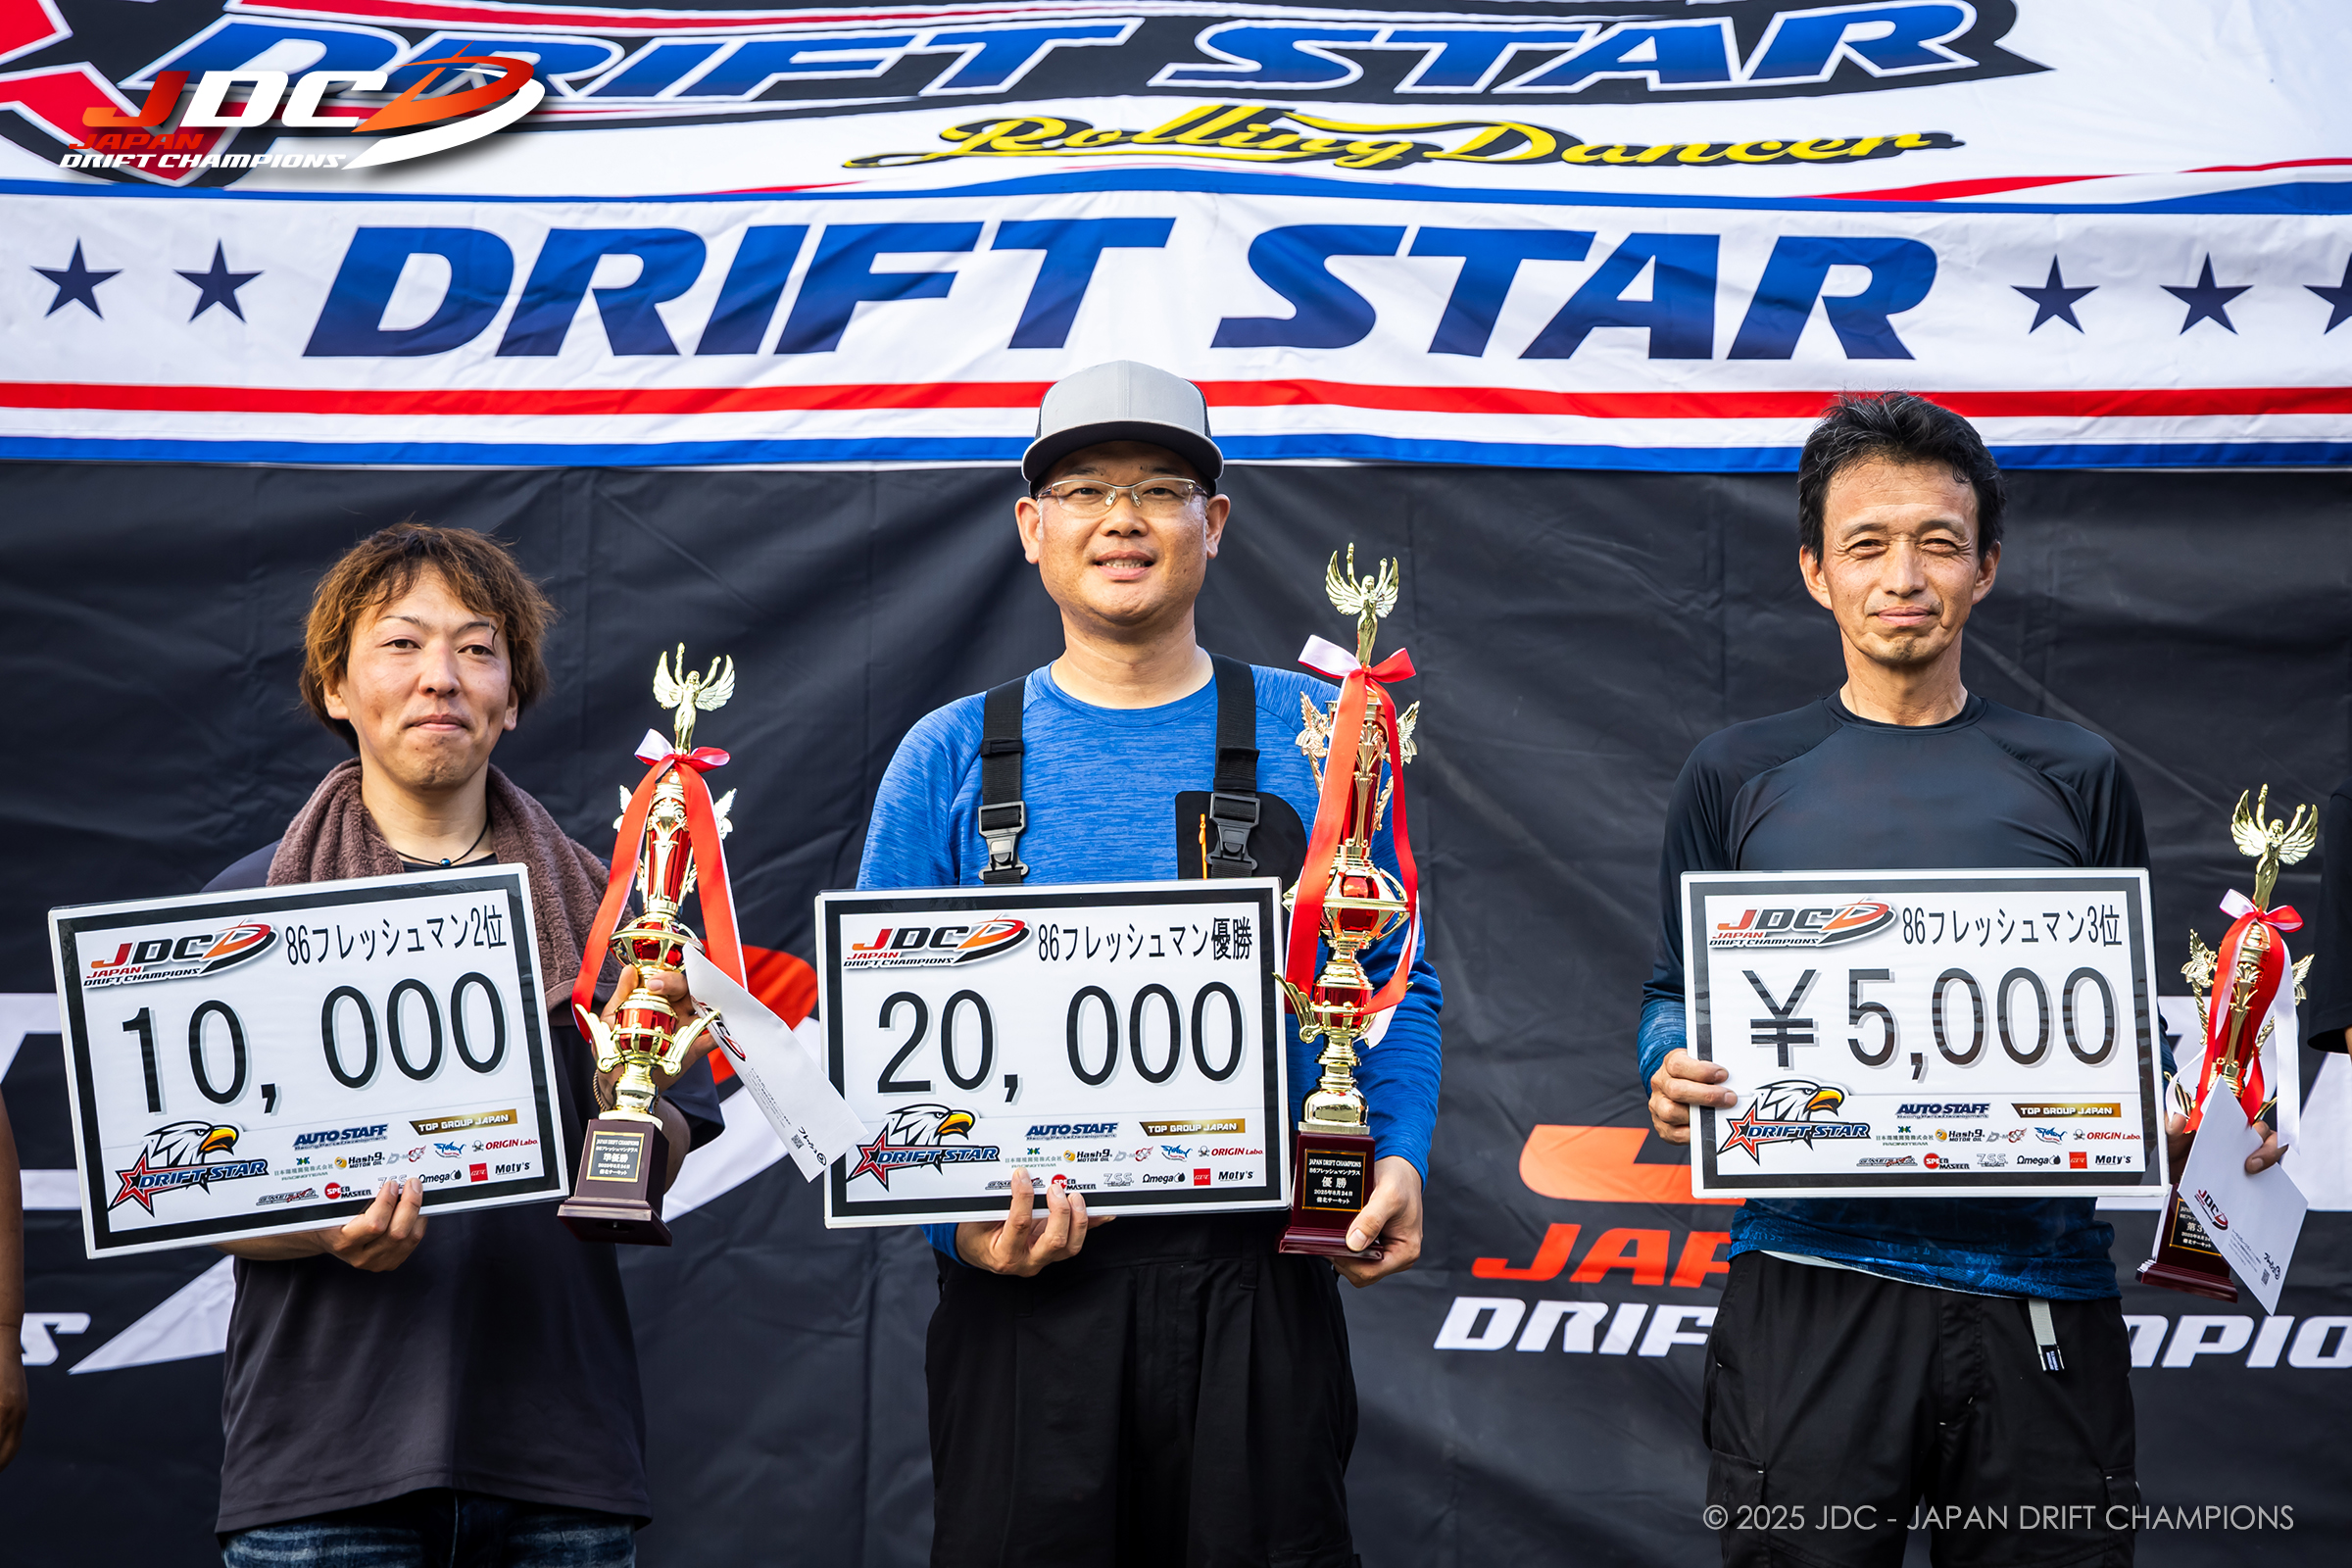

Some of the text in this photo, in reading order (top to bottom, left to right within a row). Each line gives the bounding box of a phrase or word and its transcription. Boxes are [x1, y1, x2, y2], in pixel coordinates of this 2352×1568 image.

[1147, 1, 1976, 94] STAR
[842, 105, 1965, 170] Rolling Dancer
[302, 217, 1937, 360] DRIFT STAR
[1717, 907, 1833, 931] JDC
[1902, 904, 2123, 948] 86フレッシュマン3位
[286, 904, 507, 965] 86フレッシュマン2位
[852, 926, 969, 951] JDC
[1038, 916, 1252, 963] 86フレッシュマン優勝
[91, 934, 214, 968] JDC
[84, 968, 200, 987] DRIFT CHAMPIONS
[86, 966, 141, 978] JAPAN
[1895, 1102, 1990, 1114] AUTO STAFF
[418, 1114, 509, 1132] TOP GROUP JAPAN
[1025, 1121, 1119, 1137] AUTO STAFF
[1203, 1122, 1238, 1131] JAPAN
[1747, 1124, 1868, 1138] DRIFT STAR
[293, 1123, 388, 1147] AUTO STAFF
[2086, 1131, 2121, 1140] ORIGIN
[485, 1139, 519, 1151] ORIGIN
[1211, 1148, 1245, 1156] ORIGIN
[876, 1148, 998, 1164] DRIFT STAR
[2095, 1154, 2132, 1164] Moty's
[138, 1161, 267, 1189] DRIFT STAR
[495, 1161, 530, 1175] Moty's
[1218, 1170, 1253, 1180] Moty's
[340, 1189, 371, 1199] MASTER
[1471, 1223, 1733, 1289] JAP
[1433, 1296, 1719, 1357] DRIF
